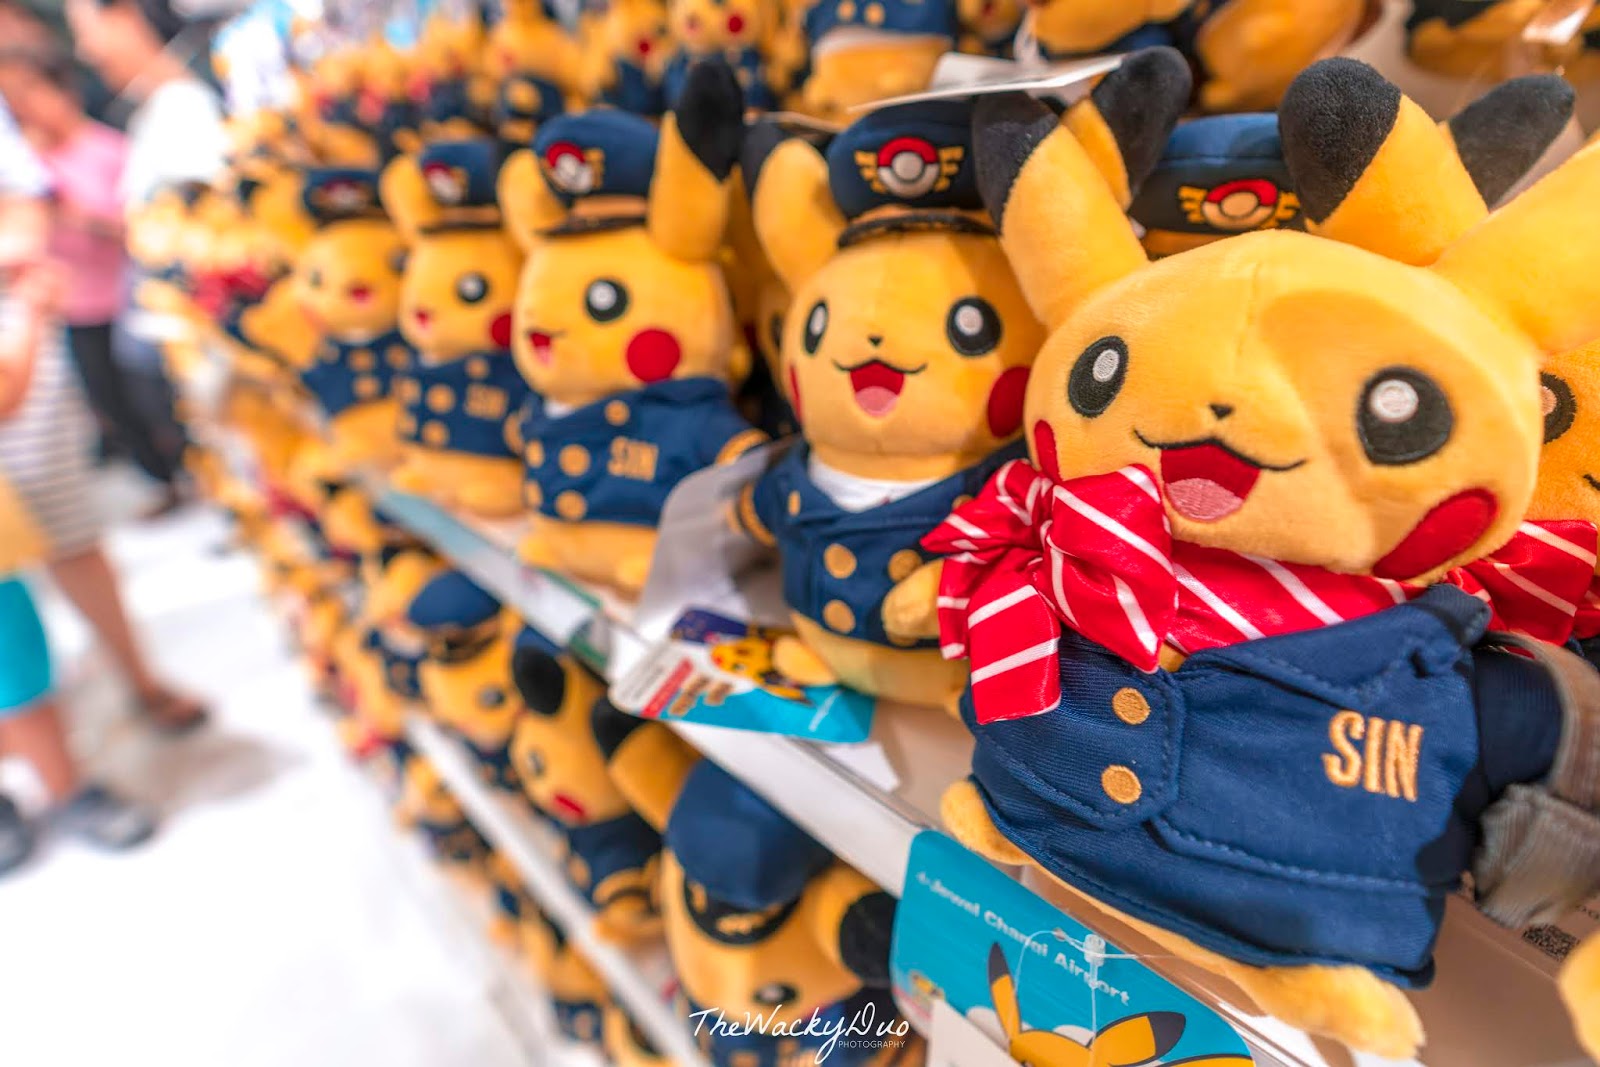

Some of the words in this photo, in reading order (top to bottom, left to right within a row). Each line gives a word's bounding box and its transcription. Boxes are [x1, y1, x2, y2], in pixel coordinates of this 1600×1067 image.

[607, 435, 659, 482] SIN
[1321, 709, 1424, 803] SIN
[984, 910, 1048, 957] Changi
